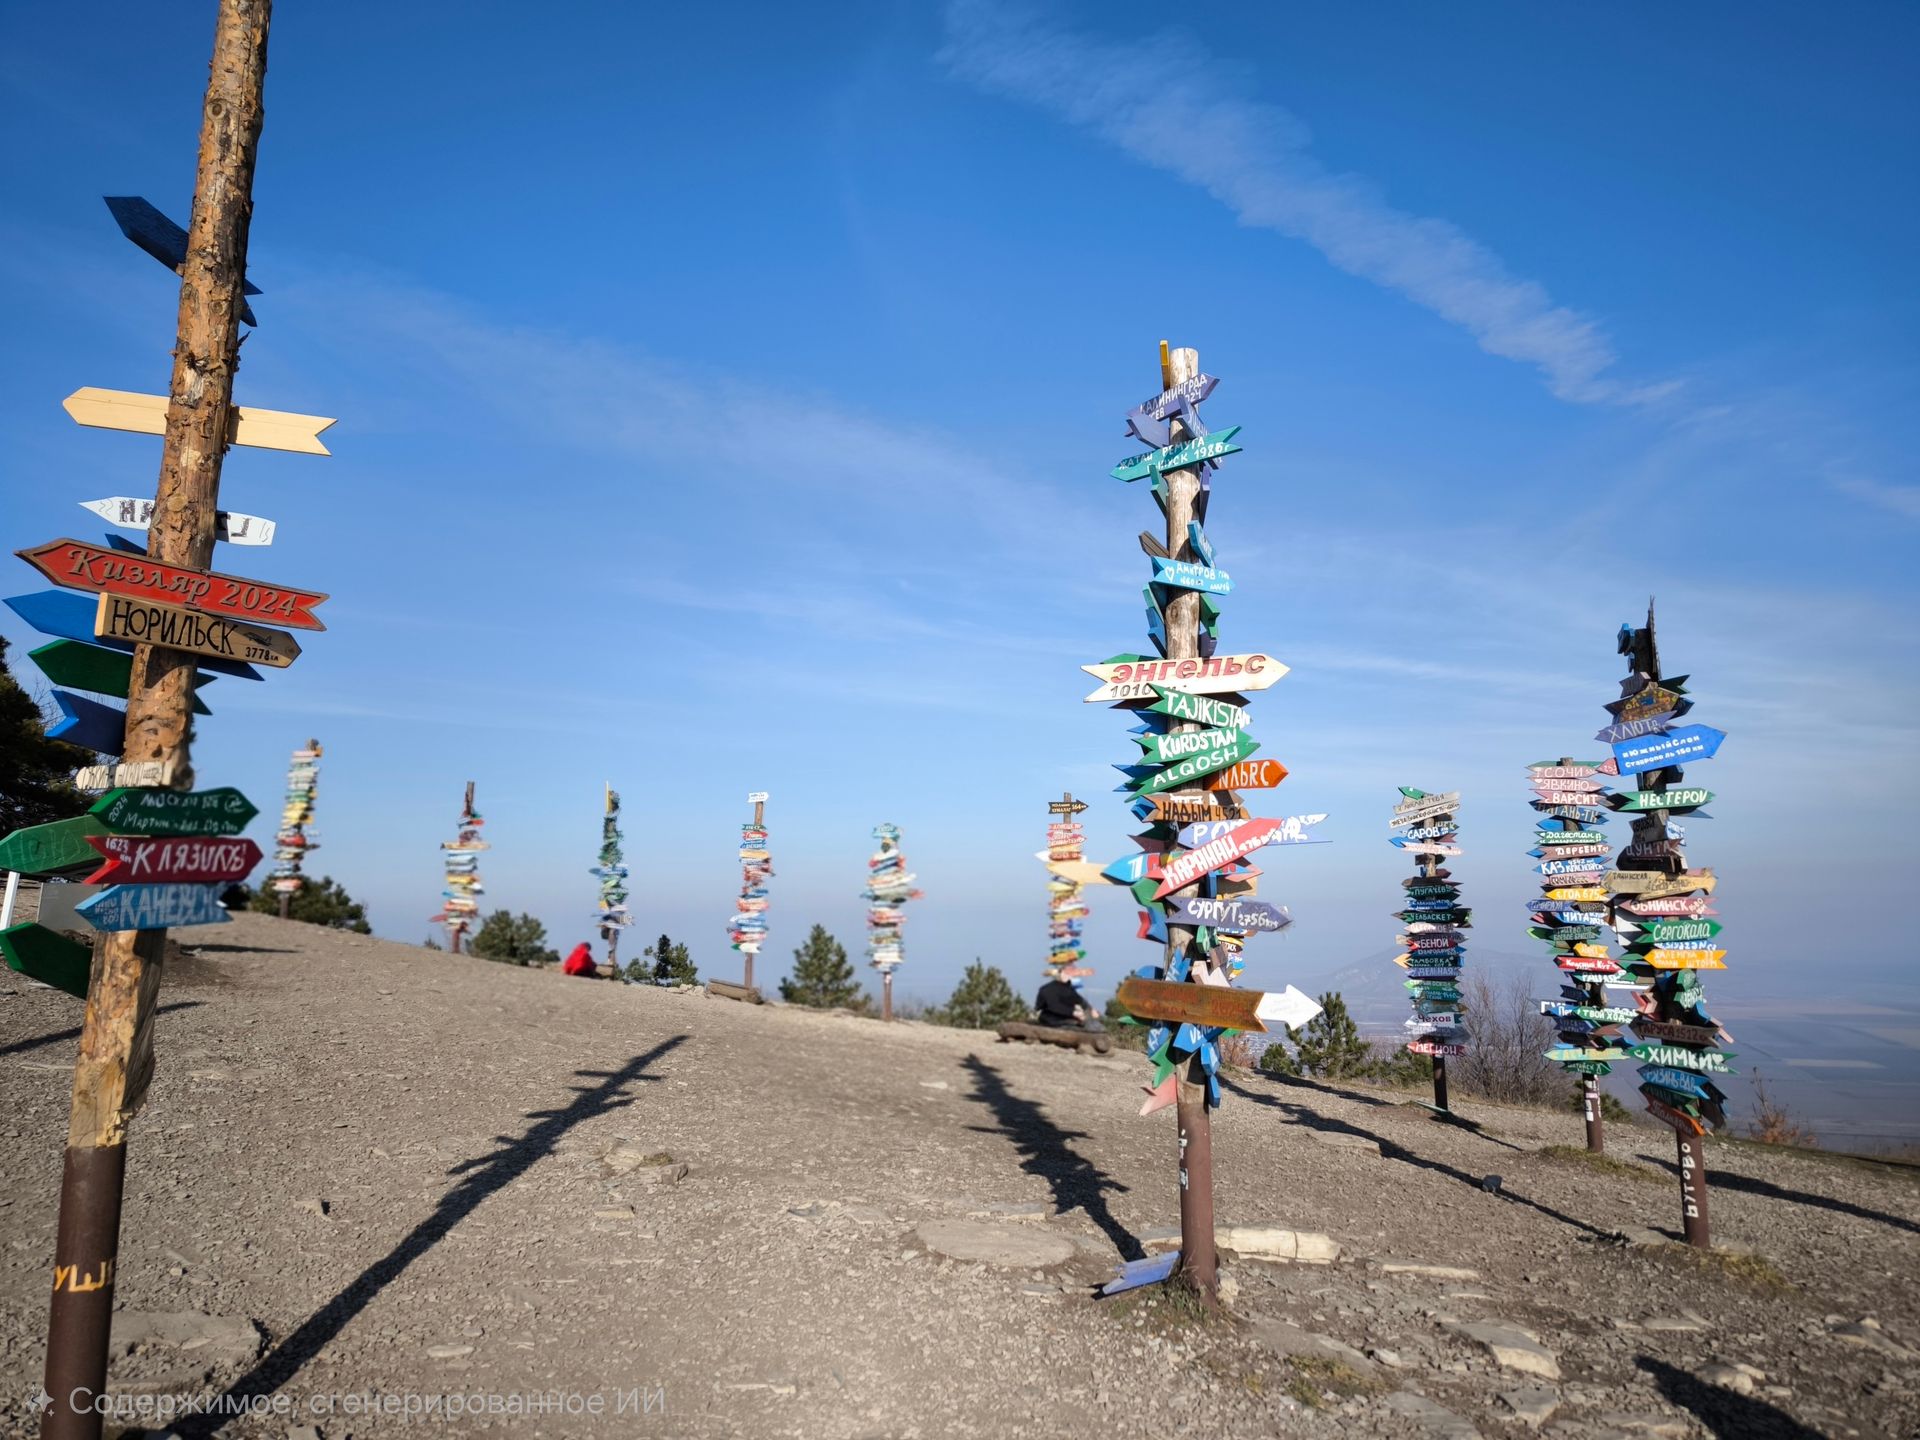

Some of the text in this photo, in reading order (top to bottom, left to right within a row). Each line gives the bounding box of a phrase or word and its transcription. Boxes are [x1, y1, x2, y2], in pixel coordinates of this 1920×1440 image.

[1140, 374, 1207, 413] КАЛИНИНГРАД
[67, 549, 299, 618] Кизляр 2024
[109, 600, 239, 655] НОРИЛЬСК
[1158, 728, 1237, 760] KURDSTAN
[1153, 746, 1239, 787] ALQOSH
[1544, 768, 1583, 778] СОЧИ
[1162, 801, 1212, 821] НАДЫМ
[1407, 828, 1440, 840] САРОВ
[1160, 833, 1239, 889] КАРАНАЙ
[1187, 900, 1243, 922] СУРГУТ
[1563, 912, 1589, 922] ЧИТА
[1421, 938, 1449, 949] БЕНОЙ
[1418, 1013, 1452, 1023] Чехов
[1647, 1046, 1714, 1072] ХИМКИ
[1681, 1142, 1699, 1218] БУТОВО
